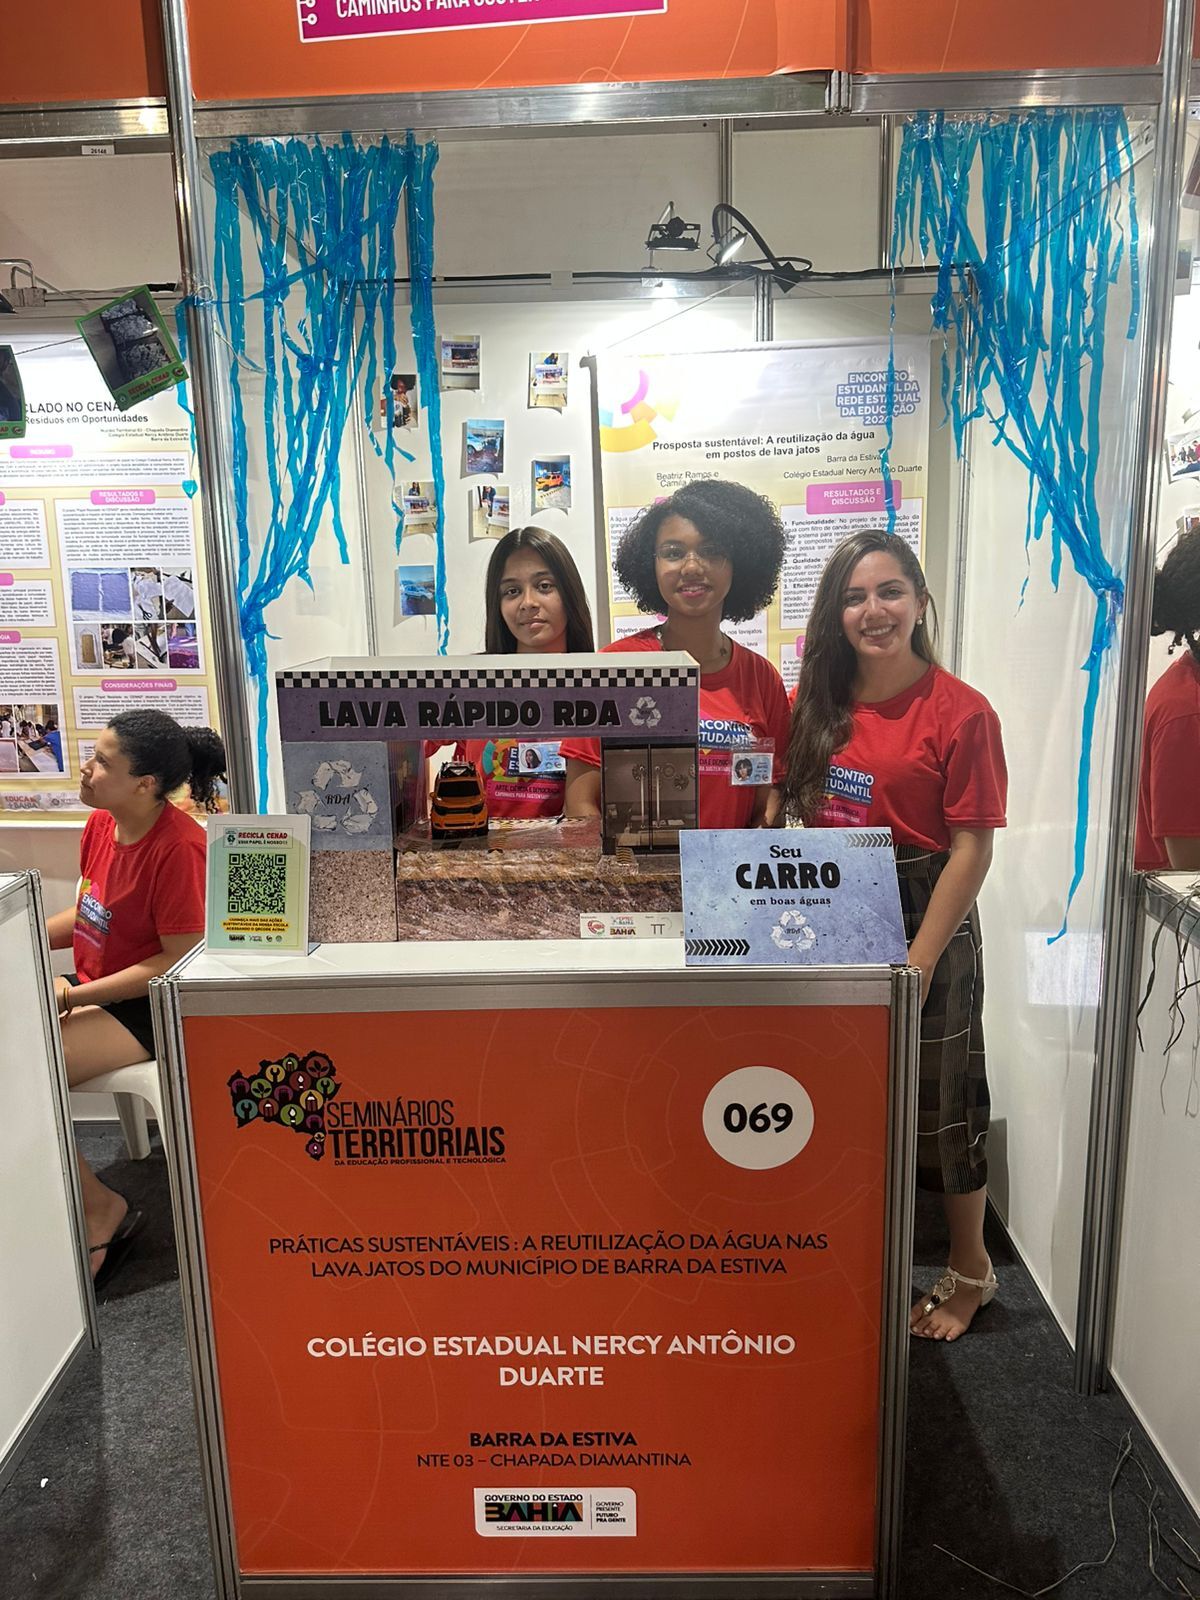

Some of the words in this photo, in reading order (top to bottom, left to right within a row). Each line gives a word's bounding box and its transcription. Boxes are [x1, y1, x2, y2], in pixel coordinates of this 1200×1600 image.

[849, 372, 906, 383] ENCONRO
[838, 384, 902, 394] ESTUDANIL
[904, 382, 918, 391] DA
[67, 401, 83, 412] NO
[837, 396, 864, 405] REDE
[866, 394, 919, 404] ESTDUAL
[842, 407, 856, 416] DA
[858, 403, 914, 416] EDUCÇÃO
[82, 414, 148, 424] Oportunidades
[653, 441, 702, 451] Prosposta
[705, 437, 764, 448] sustentável:
[776, 433, 833, 444] reutilização
[850, 431, 875, 440] água
[723, 449, 756, 460] postos
[759, 447, 771, 456] de
[774, 446, 793, 455] lava
[796, 446, 820, 456] jatos
[827, 455, 846, 463] Barra
[848, 454, 858, 462] da
[860, 453, 882, 462] Estiva
[657, 472, 683, 481] Beatriz
[783, 470, 811, 480] Colégio
[812, 468, 844, 477] Estadual
[846, 467, 867, 477] Nercy
[898, 464, 923, 473] Duarte
[824, 488, 874, 498] RESULTADOS
[832, 496, 875, 505] DISCUSSÃO
[319, 700, 406, 728] LAVA
[418, 692, 542, 728] RÁPIDO
[554, 700, 622, 727] RDA
[325, 794, 350, 805] RDA
[770, 845, 802, 858] Seu
[736, 862, 840, 889] CARRO
[771, 897, 795, 905] boas
[800, 896, 831, 906] águas
[327, 1096, 455, 1128] SEMINÁRIOS
[724, 1103, 793, 1133] 069
[328, 1126, 505, 1158] TERRITORIAIS
[347, 1158, 388, 1166] EDUCAÇÃO
[269, 1234, 364, 1254] PRÁTICAS
[368, 1232, 510, 1253] SUSTENTÁVEIS
[514, 1240, 518, 1250] :
[522, 1236, 538, 1250] A
[541, 1230, 685, 1254] REUTILIZAÇÃO
[689, 1234, 720, 1250] DA
[724, 1230, 779, 1250] ÁGUA
[786, 1234, 828, 1249] NAS
[312, 1261, 360, 1277] LAVA
[364, 1261, 425, 1277] JATOS
[429, 1260, 461, 1276] DO
[466, 1256, 577, 1275] MUNICÍPIO
[582, 1259, 609, 1274] DE
[614, 1259, 683, 1274] BARRA
[687, 1258, 717, 1274] DA
[721, 1258, 787, 1274] ESTIVA
[306, 1332, 427, 1358] COLÉGIO
[434, 1335, 566, 1356] ESTADUAL
[573, 1334, 664, 1355] NERCY
[666, 1329, 796, 1355] ANTÔNIO
[499, 1366, 604, 1386] DUARTE
[470, 1432, 535, 1446] BARRA
[540, 1432, 569, 1446] DA
[573, 1432, 638, 1446] ESTIVA
[417, 1454, 450, 1467] NTE
[453, 1454, 474, 1467] 03
[490, 1454, 577, 1467] CHAPADA
[580, 1453, 692, 1466] DIAMANTINA
[485, 1502, 583, 1522] BAHIA
